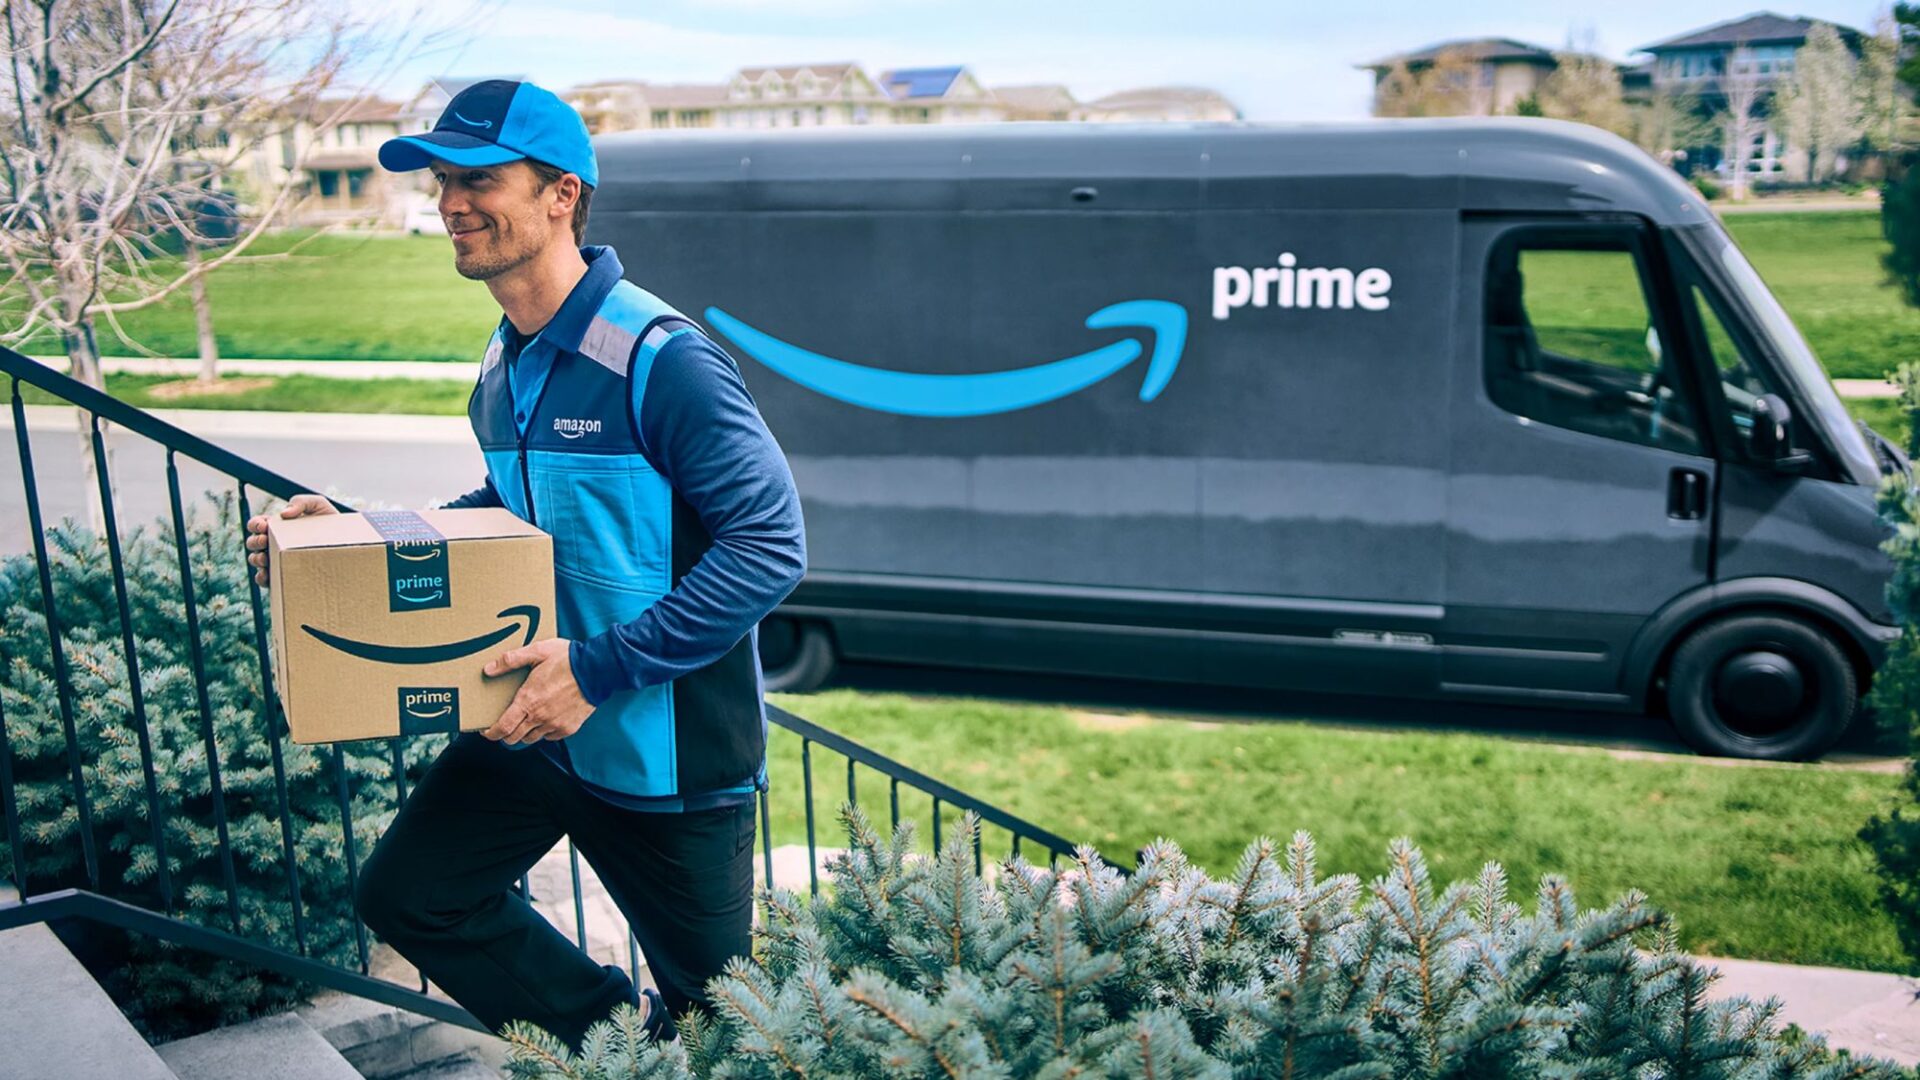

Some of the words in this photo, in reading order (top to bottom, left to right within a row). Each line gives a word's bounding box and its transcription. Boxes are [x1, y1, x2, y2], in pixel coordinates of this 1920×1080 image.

[1212, 252, 1392, 320] prime
[553, 418, 601, 432] amazon
[396, 575, 443, 593] prime
[406, 690, 451, 708] prime
